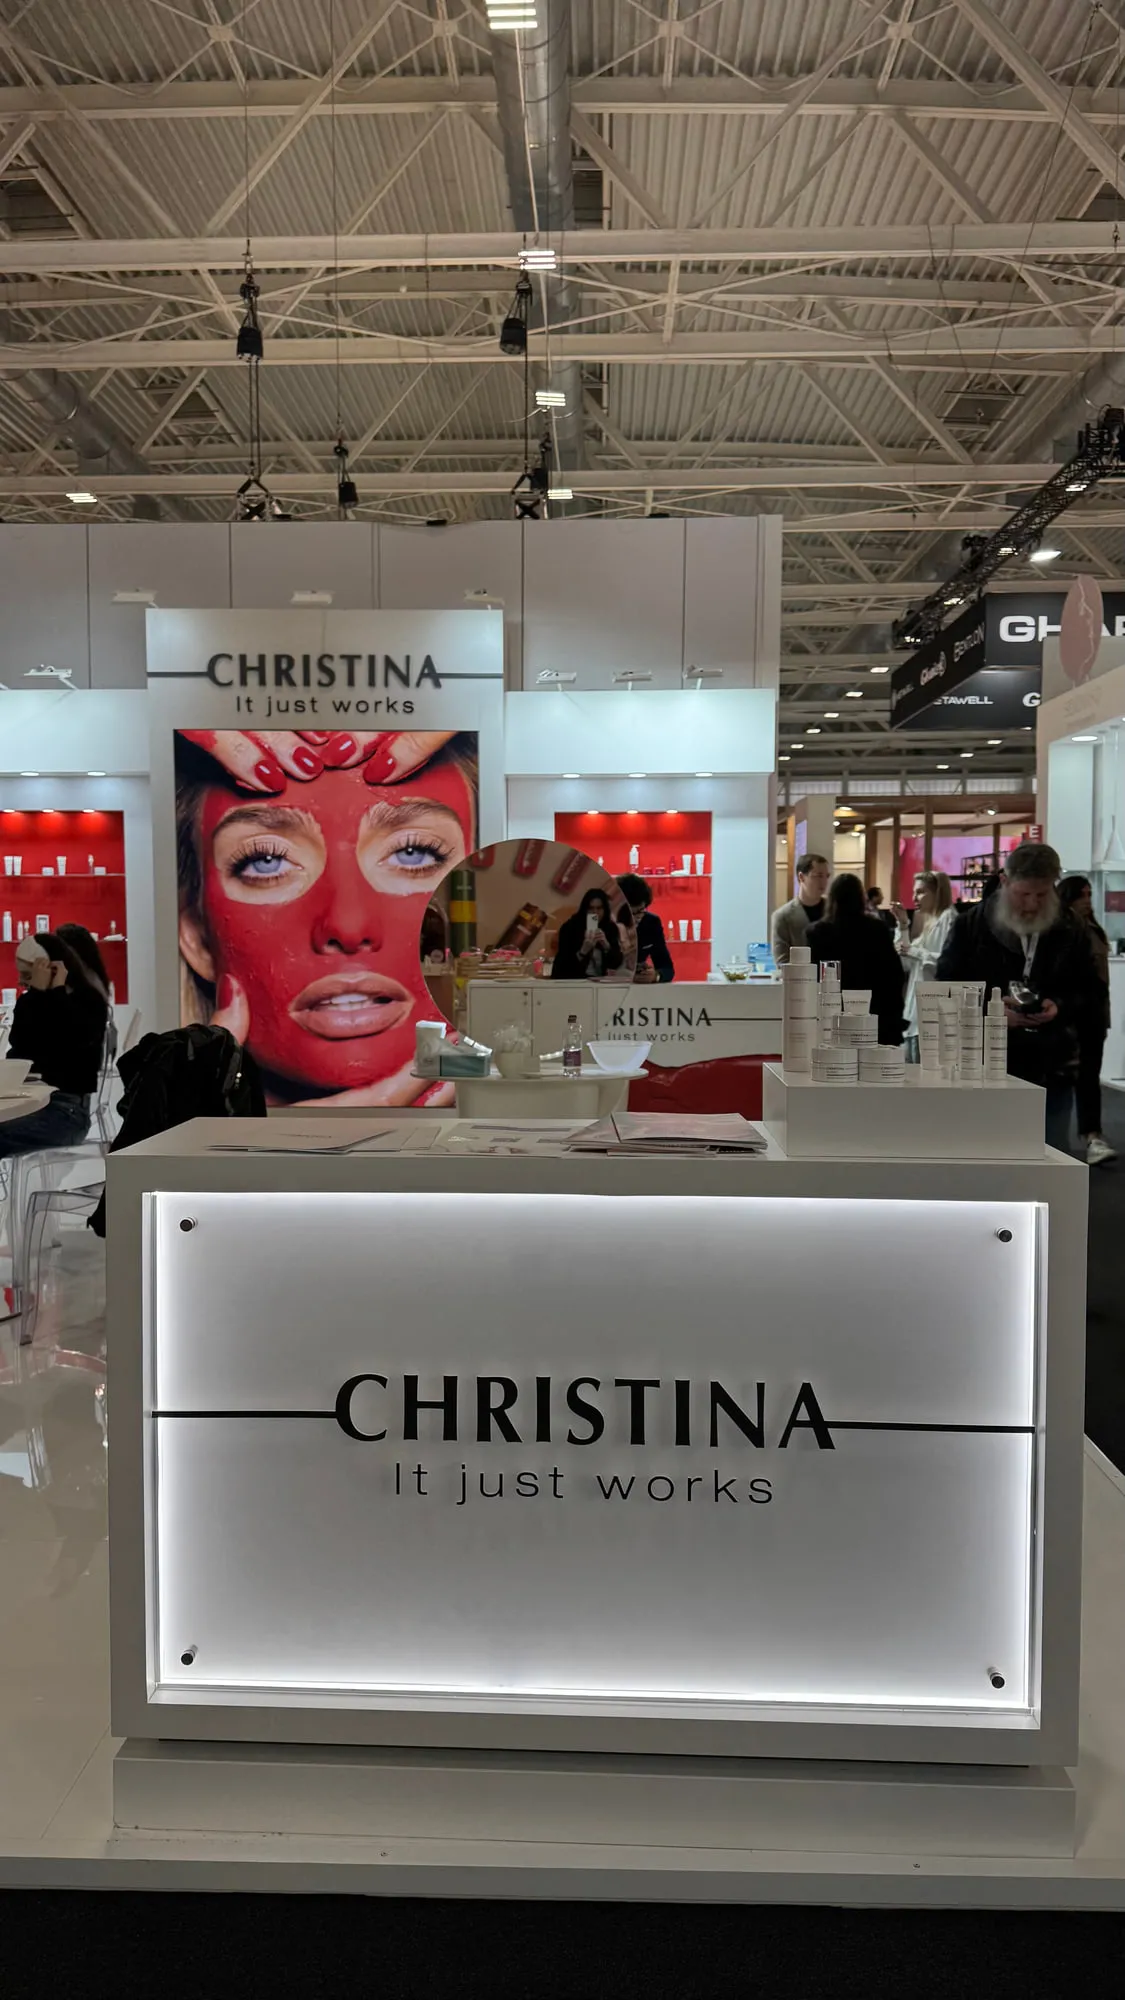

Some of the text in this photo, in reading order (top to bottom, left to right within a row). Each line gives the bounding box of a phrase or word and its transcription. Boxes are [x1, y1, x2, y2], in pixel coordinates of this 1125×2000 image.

[207, 653, 442, 689] CHRISTINA
[236, 696, 415, 717] It just works
[604, 1006, 712, 1027] RISTINA
[646, 1031, 696, 1042] works
[335, 1372, 836, 1450] CHRISTINA
[395, 1462, 774, 1506] It just works
